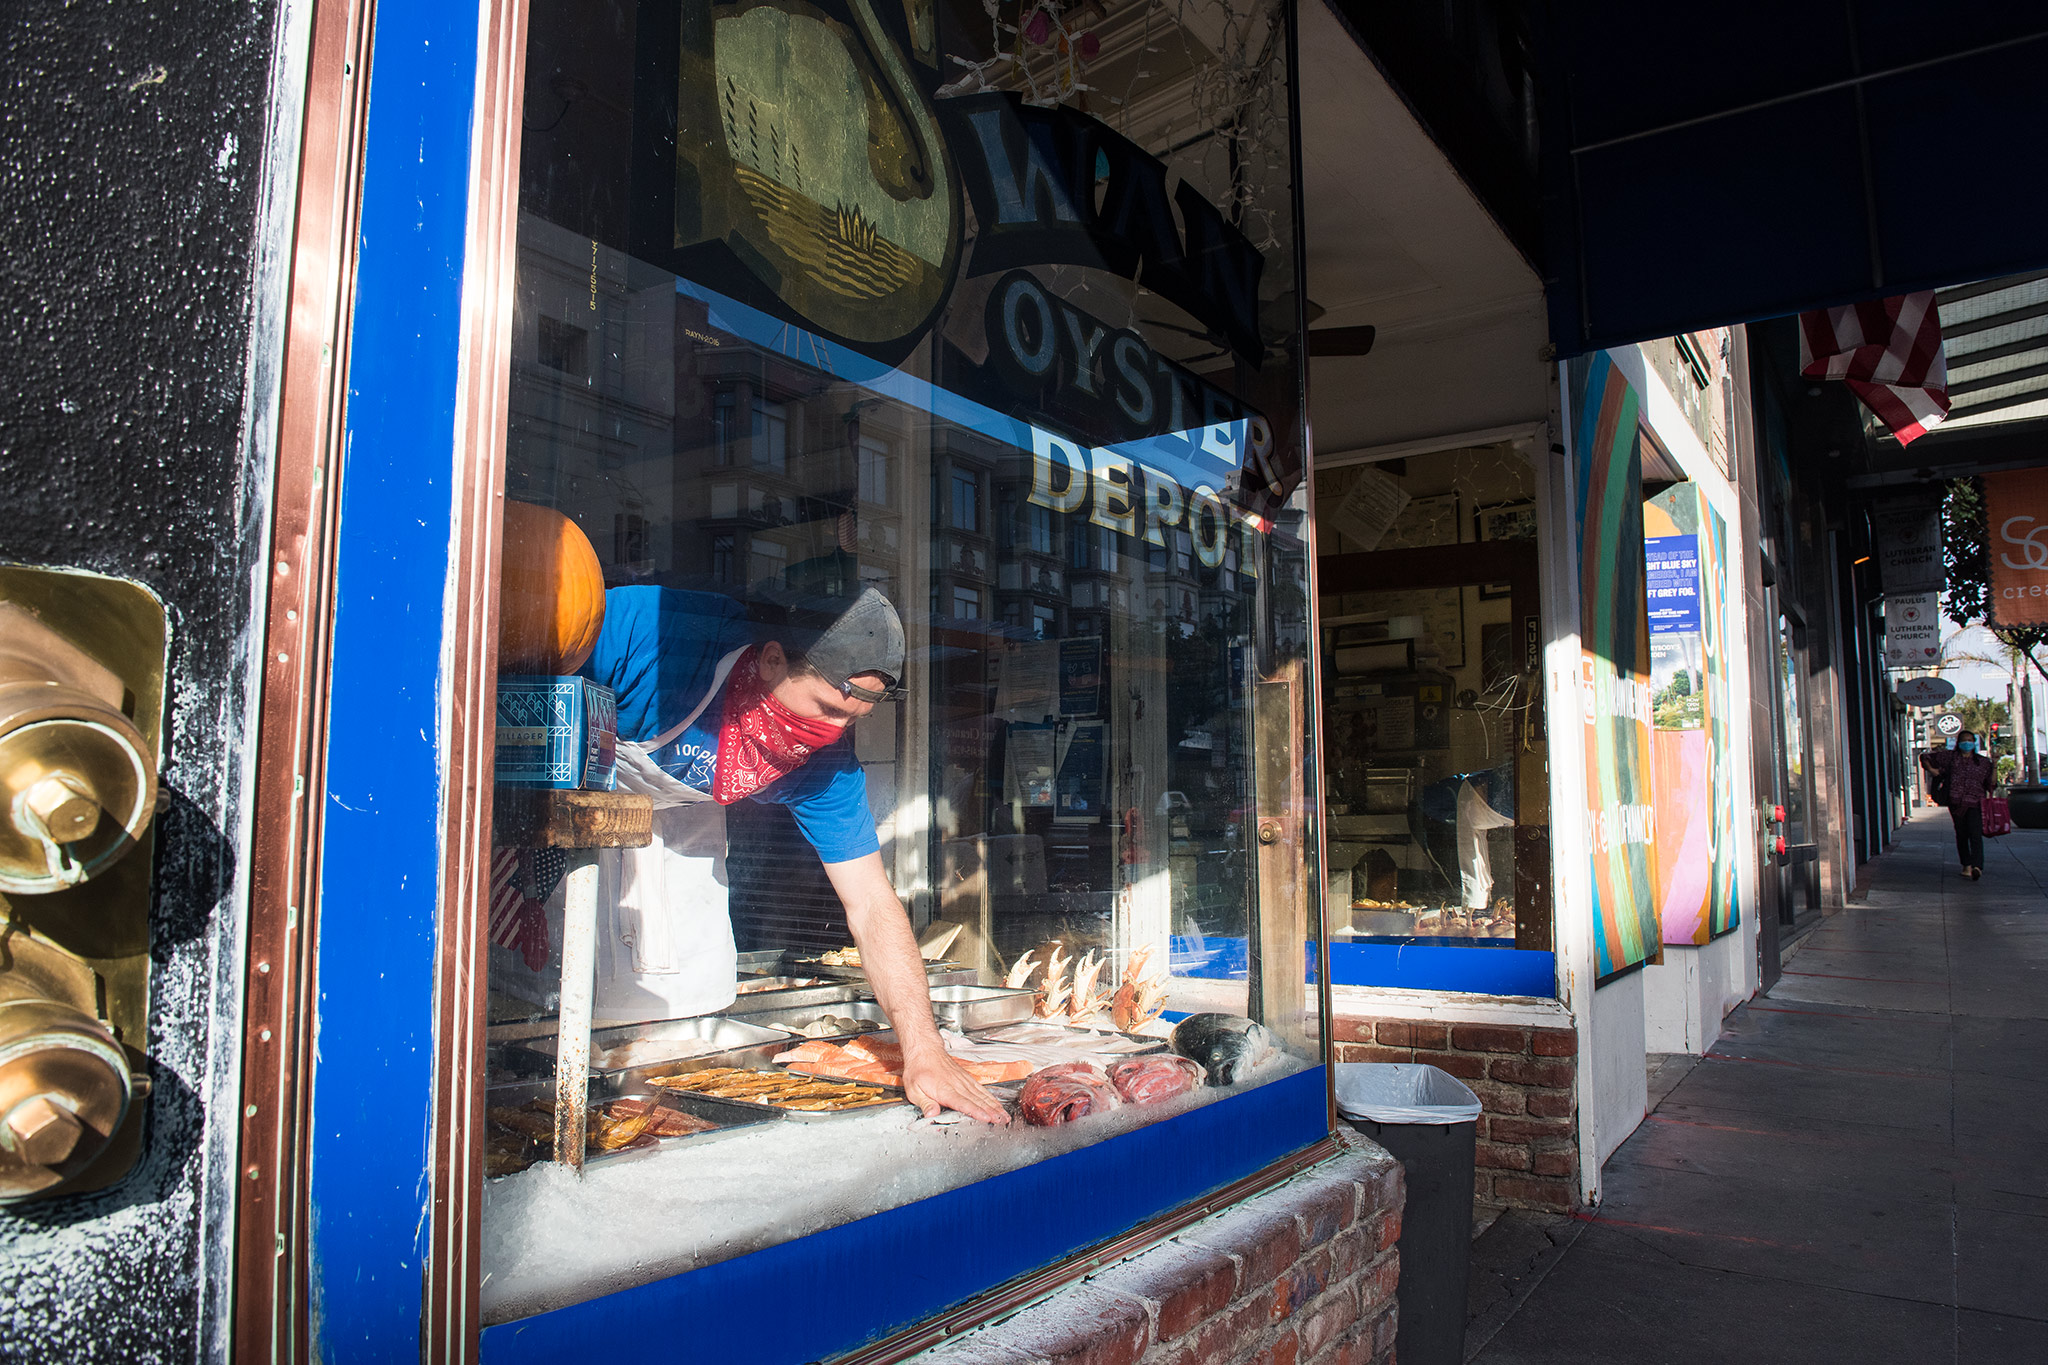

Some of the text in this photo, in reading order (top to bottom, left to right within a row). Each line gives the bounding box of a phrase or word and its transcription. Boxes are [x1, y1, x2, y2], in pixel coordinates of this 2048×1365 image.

[1003, 278, 1284, 497] OYSTER
[1026, 418, 1258, 580] DEPOT
[1885, 545, 1936, 558] LUTHERAN
[1661, 560, 1681, 570] BLUE
[1681, 558, 1697, 569] SKY
[1891, 555, 1933, 567] CHURCH
[1647, 589, 1657, 599] FT
[1657, 588, 1678, 598] GREY
[1895, 597, 1926, 605] PAULUS
[1891, 624, 1934, 633] LUTHERAN
[1895, 632, 1931, 641] CHURCH
[1928, 692, 1947, 700] PEDI
[497, 731, 544, 741] VILLAGER
